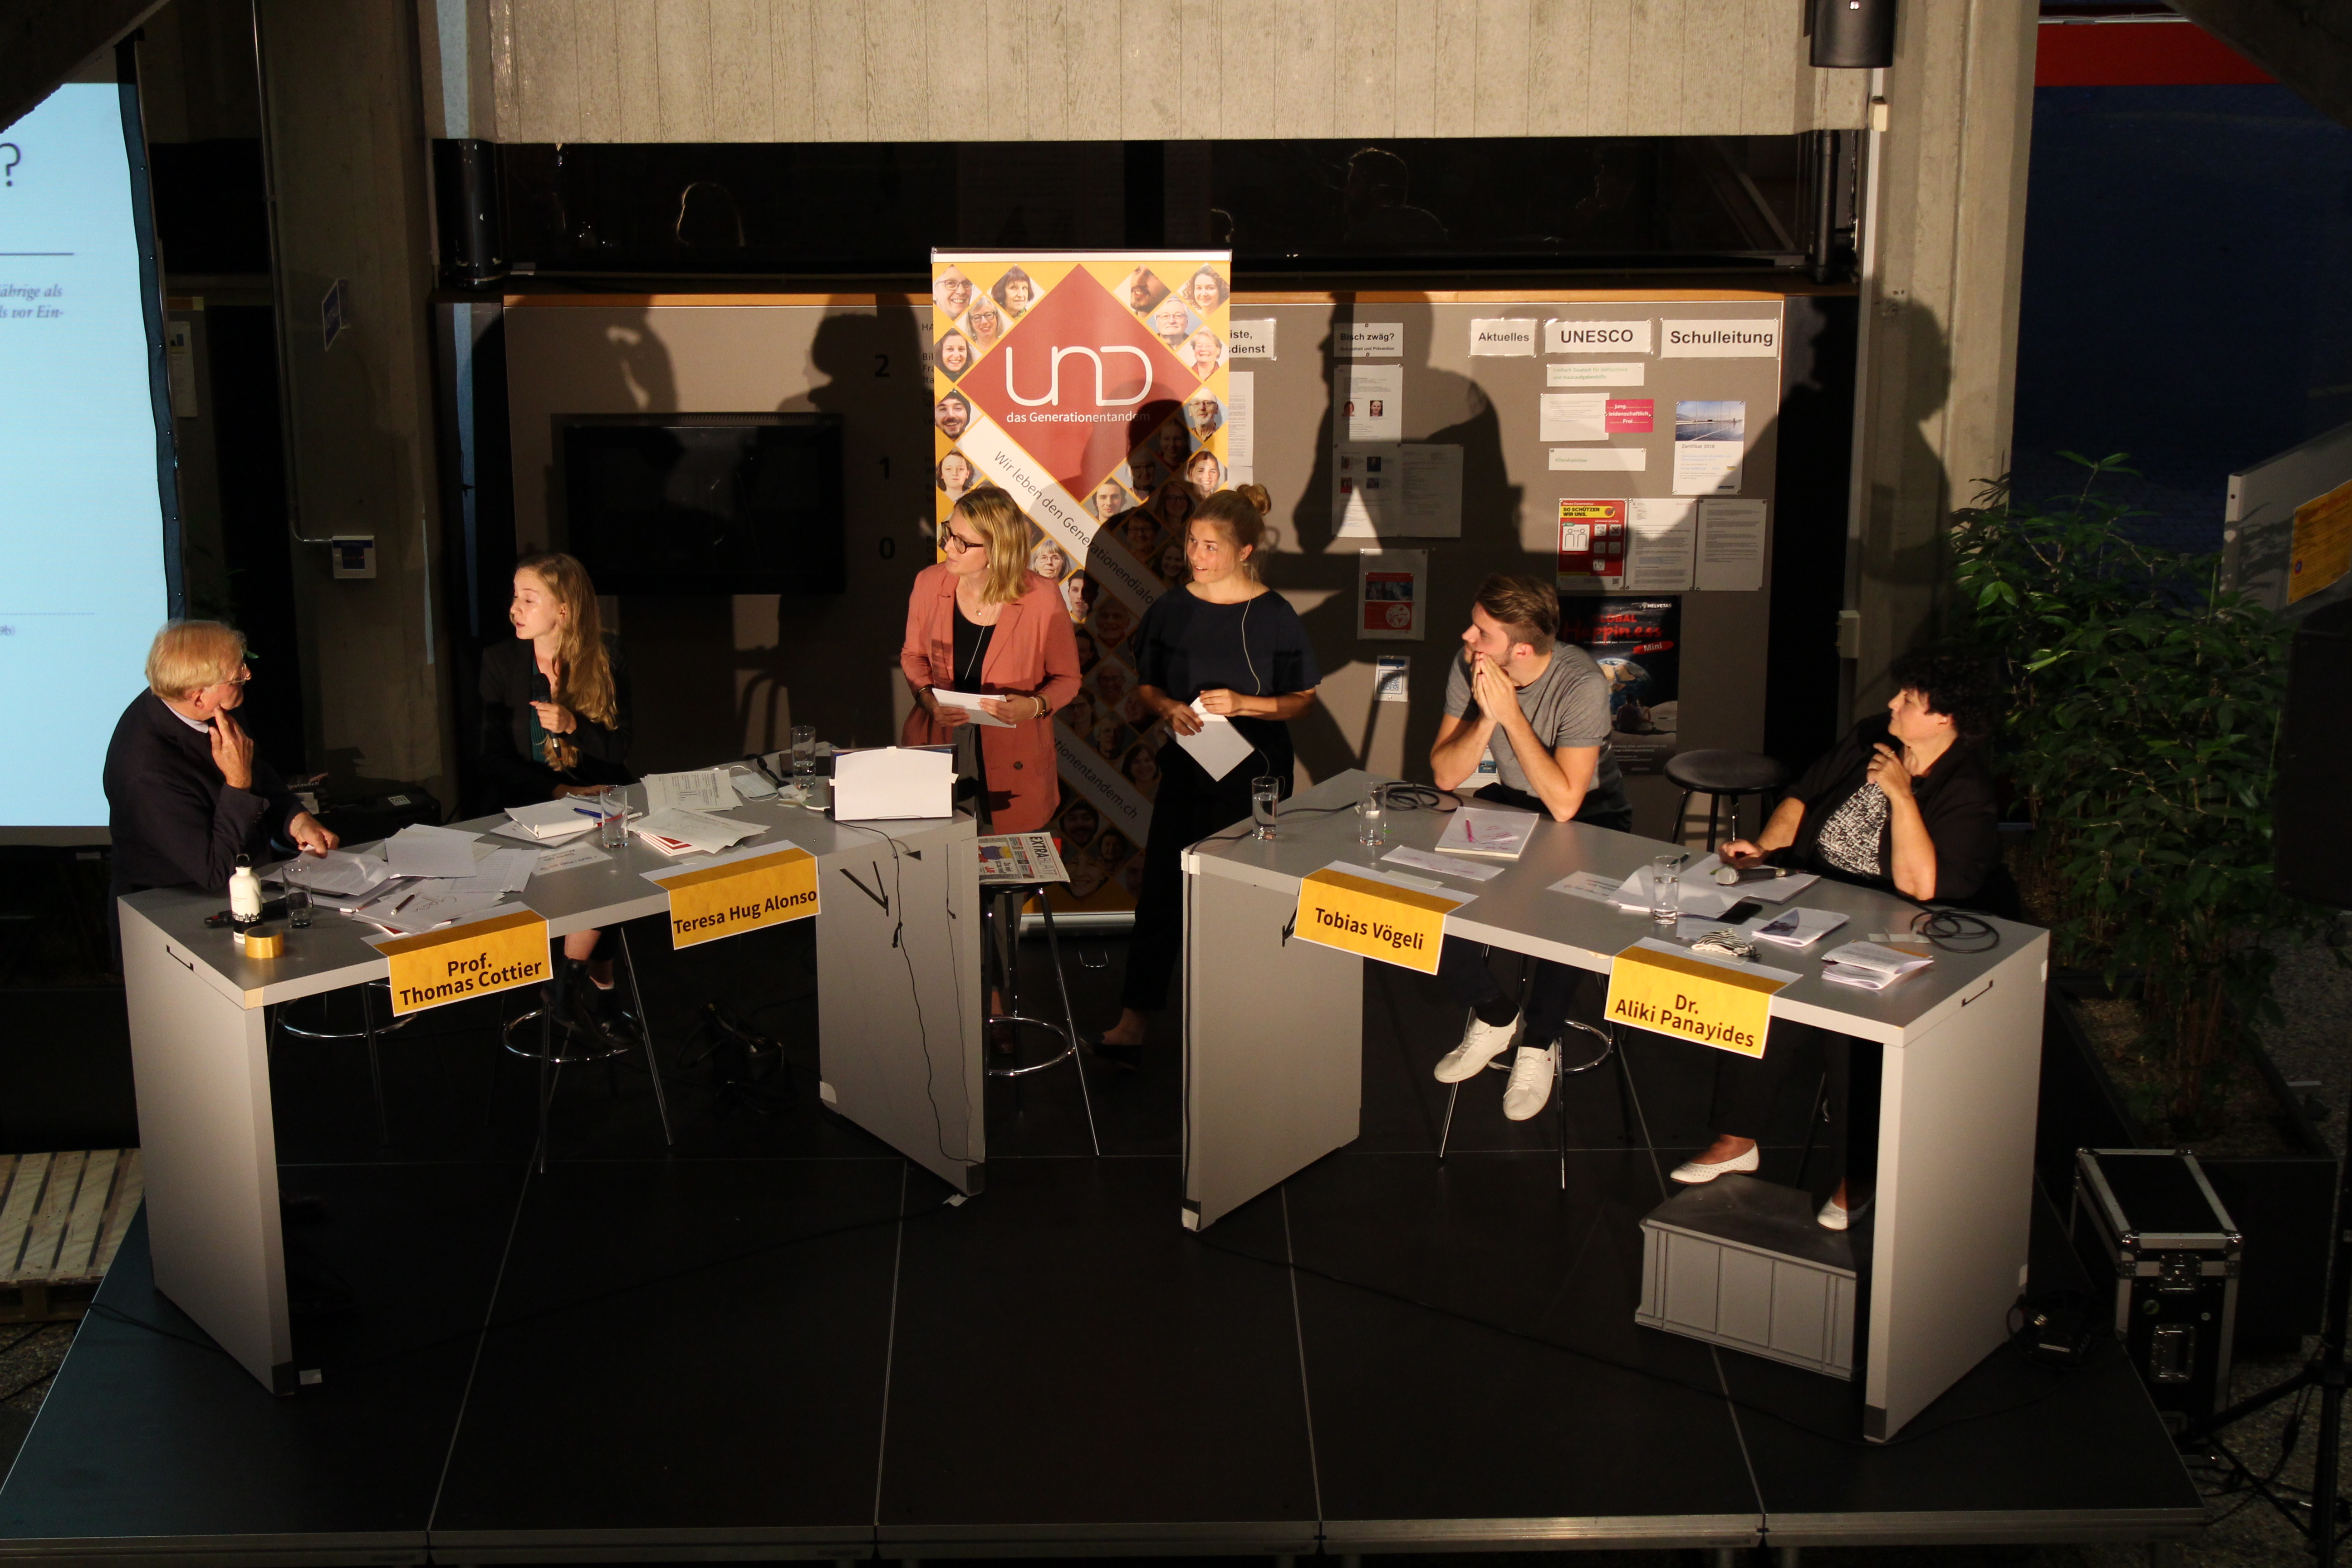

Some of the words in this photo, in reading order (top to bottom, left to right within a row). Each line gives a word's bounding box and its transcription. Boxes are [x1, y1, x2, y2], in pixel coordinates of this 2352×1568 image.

[44, 285, 63, 298] als
[13, 308, 33, 318] vor
[36, 306, 64, 318] Ein-
[1230, 330, 1253, 340] iste,
[1367, 333, 1395, 342] zwäg?
[1478, 332, 1529, 342] Aktuelles
[1561, 329, 1633, 343] UNESCO
[1670, 330, 1773, 347] Schulleitung
[875, 354, 890, 377] 2
[1006, 412, 1027, 423] das
[1029, 411, 1150, 423] Generationentandem
[879, 457, 889, 479] 1
[995, 451, 1014, 471] Wir
[1012, 468, 1043, 500] leben
[1042, 498, 1063, 519] den
[1063, 517, 1154, 605] Generationendialo
[879, 537, 895, 559] 0
[1643, 642, 1662, 652] Mini
[1029, 837, 1058, 876] EXTRABLATT
[673, 912, 725, 934] Teresa
[730, 904, 761, 921] Hug
[764, 890, 817, 912] Alonso
[1315, 907, 1368, 936] Tobias
[1373, 922, 1424, 950] Vögeli
[447, 952, 492, 977] Prof.
[400, 978, 474, 1006] Thomas
[479, 961, 542, 987] Cottier
[1675, 994, 1699, 1014] Dr.
[1614, 999, 1656, 1022] Aliki
[1660, 1009, 1754, 1047] Panayides
